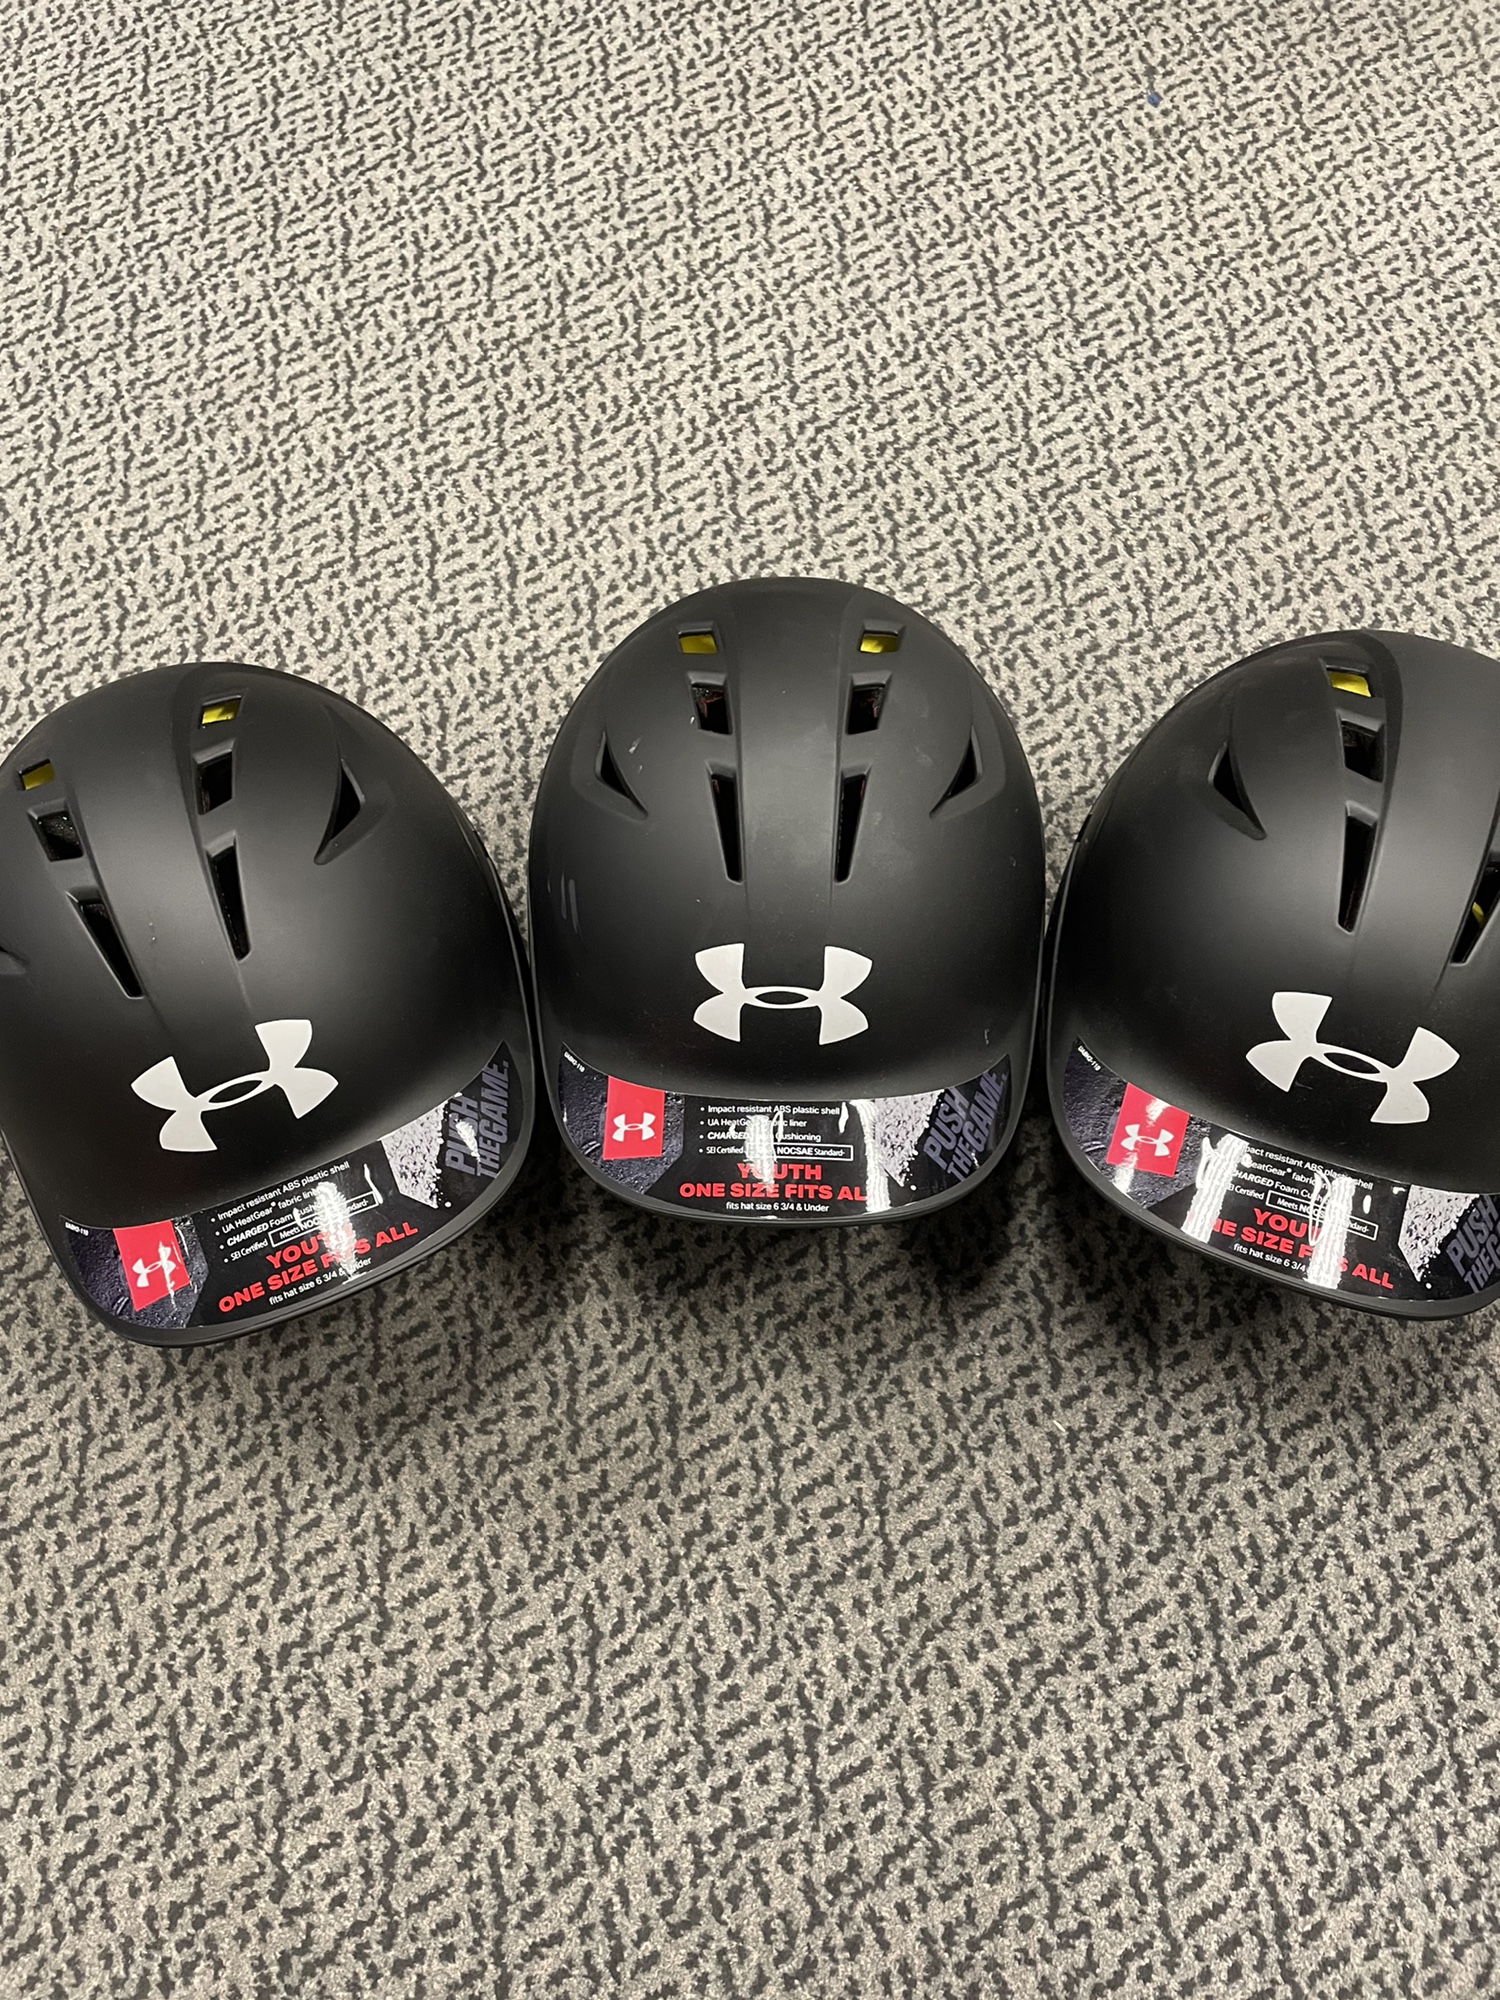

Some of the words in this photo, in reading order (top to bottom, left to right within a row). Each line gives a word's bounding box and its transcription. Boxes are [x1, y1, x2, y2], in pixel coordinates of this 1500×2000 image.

[707, 1118, 719, 1126] UA
[789, 1119, 807, 1127] liner
[708, 1105, 735, 1114] Impact
[737, 1105, 772, 1113] resistant
[773, 1105, 791, 1113] ABS
[793, 1105, 819, 1114] plastic
[821, 1107, 840, 1115] shell
[923, 1087, 970, 1171] PUSH
[716, 1146, 743, 1154] Certified
[776, 1146, 813, 1155] NOCSAE
[1234, 1169, 1274, 1188] HARGED
[1274, 1180, 1299, 1195] Foam
[1264, 1151, 1303, 1168] resistant
[1303, 1162, 1324, 1173] ABS
[1354, 1178, 1374, 1191] shell
[217, 1206, 246, 1221] Impact
[246, 1188, 282, 1207] resistant
[282, 1180, 301, 1193] ABS
[301, 1169, 329, 1186] plastic
[330, 1161, 350, 1175] shell
[679, 1183, 725, 1198] ONE
[730, 1183, 780, 1198] SIZE
[785, 1184, 833, 1200] FITS
[837, 1186, 873, 1201] AL
[726, 1201, 739, 1210] fits
[740, 1202, 754, 1210] hat
[755, 1202, 772, 1211] size
[774, 1202, 780, 1211] 6
[780, 1202, 795, 1211] 3/4
[796, 1203, 803, 1211] &
[804, 1203, 830, 1212] Under
[1234, 1185, 1265, 1200] Certified
[1276, 1197, 1300, 1211] Meets
[222, 1223, 235, 1234] UA
[277, 1194, 303, 1209] fabric
[227, 1223, 269, 1247] CHARGED
[270, 1213, 294, 1228] Foam
[1253, 1208, 1330, 1246] YOU
[241, 1239, 268, 1256] Certified
[279, 1227, 301, 1240] Meets
[266, 1224, 352, 1269] YOU
[1445, 1194, 1499, 1278] PUSH
[218, 1282, 265, 1313] ONE
[268, 1259, 318, 1291] SIZE
[320, 1238, 371, 1269] FS
[375, 1222, 418, 1248] ALL
[1233, 1243, 1249, 1254] fits
[1249, 1247, 1265, 1260] hat
[1265, 1253, 1283, 1266] size
[1283, 1259, 1291, 1268] 6
[1291, 1261, 1306, 1272] 3/4
[1241, 1226, 1294, 1255] SIZE
[1352, 1263, 1394, 1289] ALL
[269, 1293, 283, 1305] fits
[283, 1289, 299, 1301] hat
[298, 1281, 316, 1295] size
[315, 1276, 323, 1285] 6
[322, 1270, 338, 1282] 3/4
